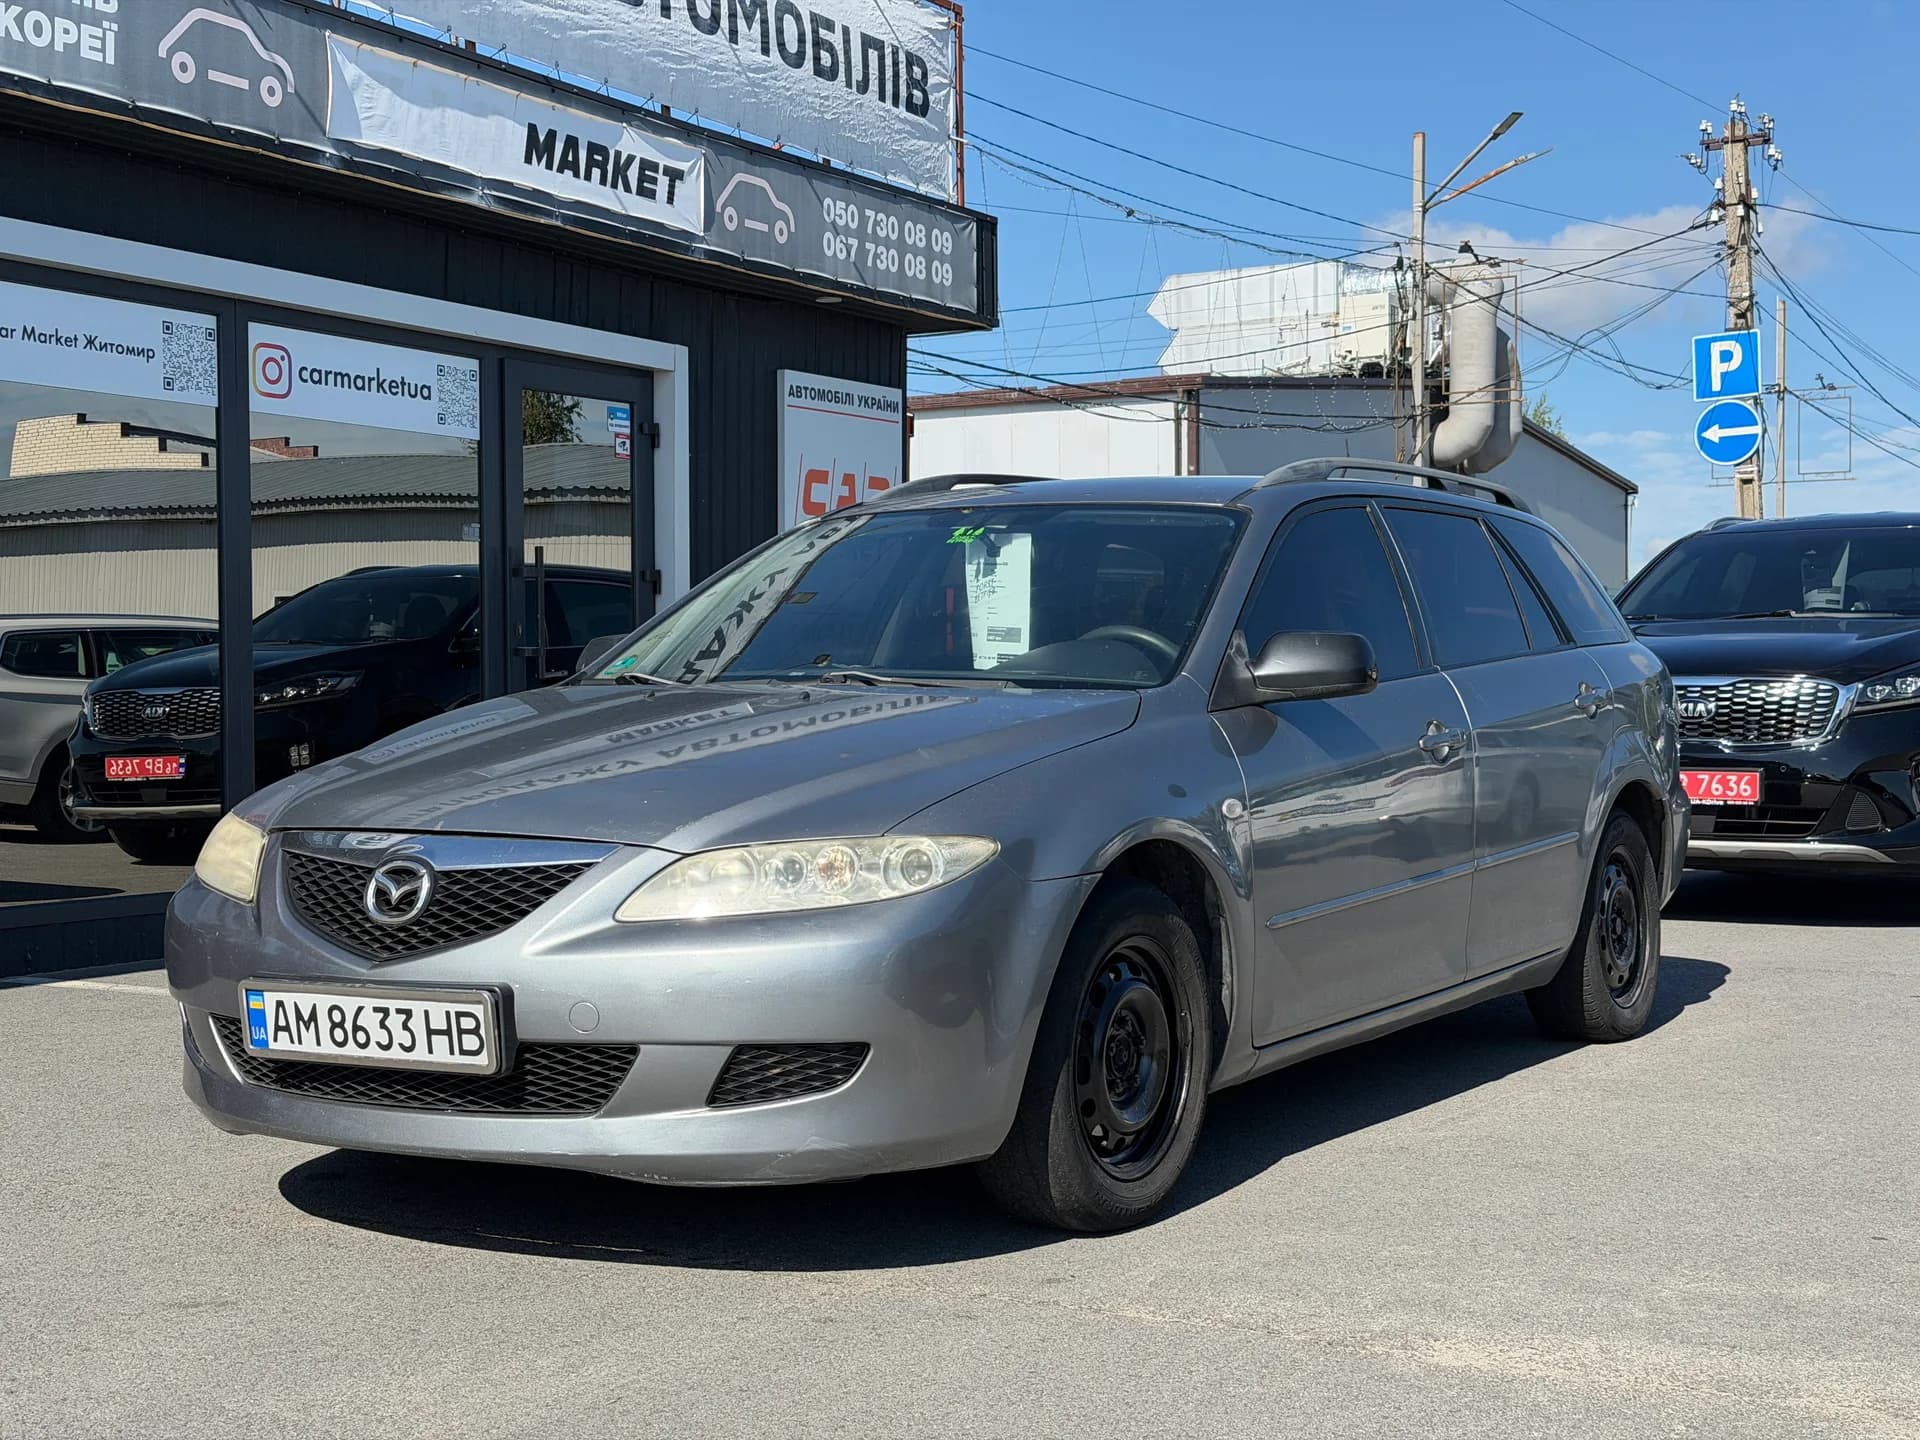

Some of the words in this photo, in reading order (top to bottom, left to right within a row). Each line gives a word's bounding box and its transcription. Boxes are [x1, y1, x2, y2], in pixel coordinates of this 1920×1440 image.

[0, 2, 119, 65] КОРЕЇ
[617, 0, 930, 118] ОМОБІЛІВ
[523, 122, 685, 206] MARKET
[823, 197, 859, 229] 050
[865, 208, 899, 241] 730
[904, 220, 927, 248] 08
[931, 228, 953, 255] 09
[823, 231, 859, 263] 067
[865, 241, 899, 273] 730
[904, 253, 927, 280] 08
[931, 260, 953, 287] 09
[21, 324, 79, 348] Market
[82, 333, 156, 364] Житомир
[1710, 340, 1743, 392] P
[298, 363, 432, 401] carmarketua
[788, 384, 854, 407] АВТОМОБІЛІ
[857, 394, 899, 414] УКРАЇНИ
[803, 468, 889, 516] CA
[1678, 702, 1707, 717] KIA
[1696, 774, 1752, 797] 7636
[252, 1026, 267, 1041] UA
[327, 1004, 416, 1053] 8633
